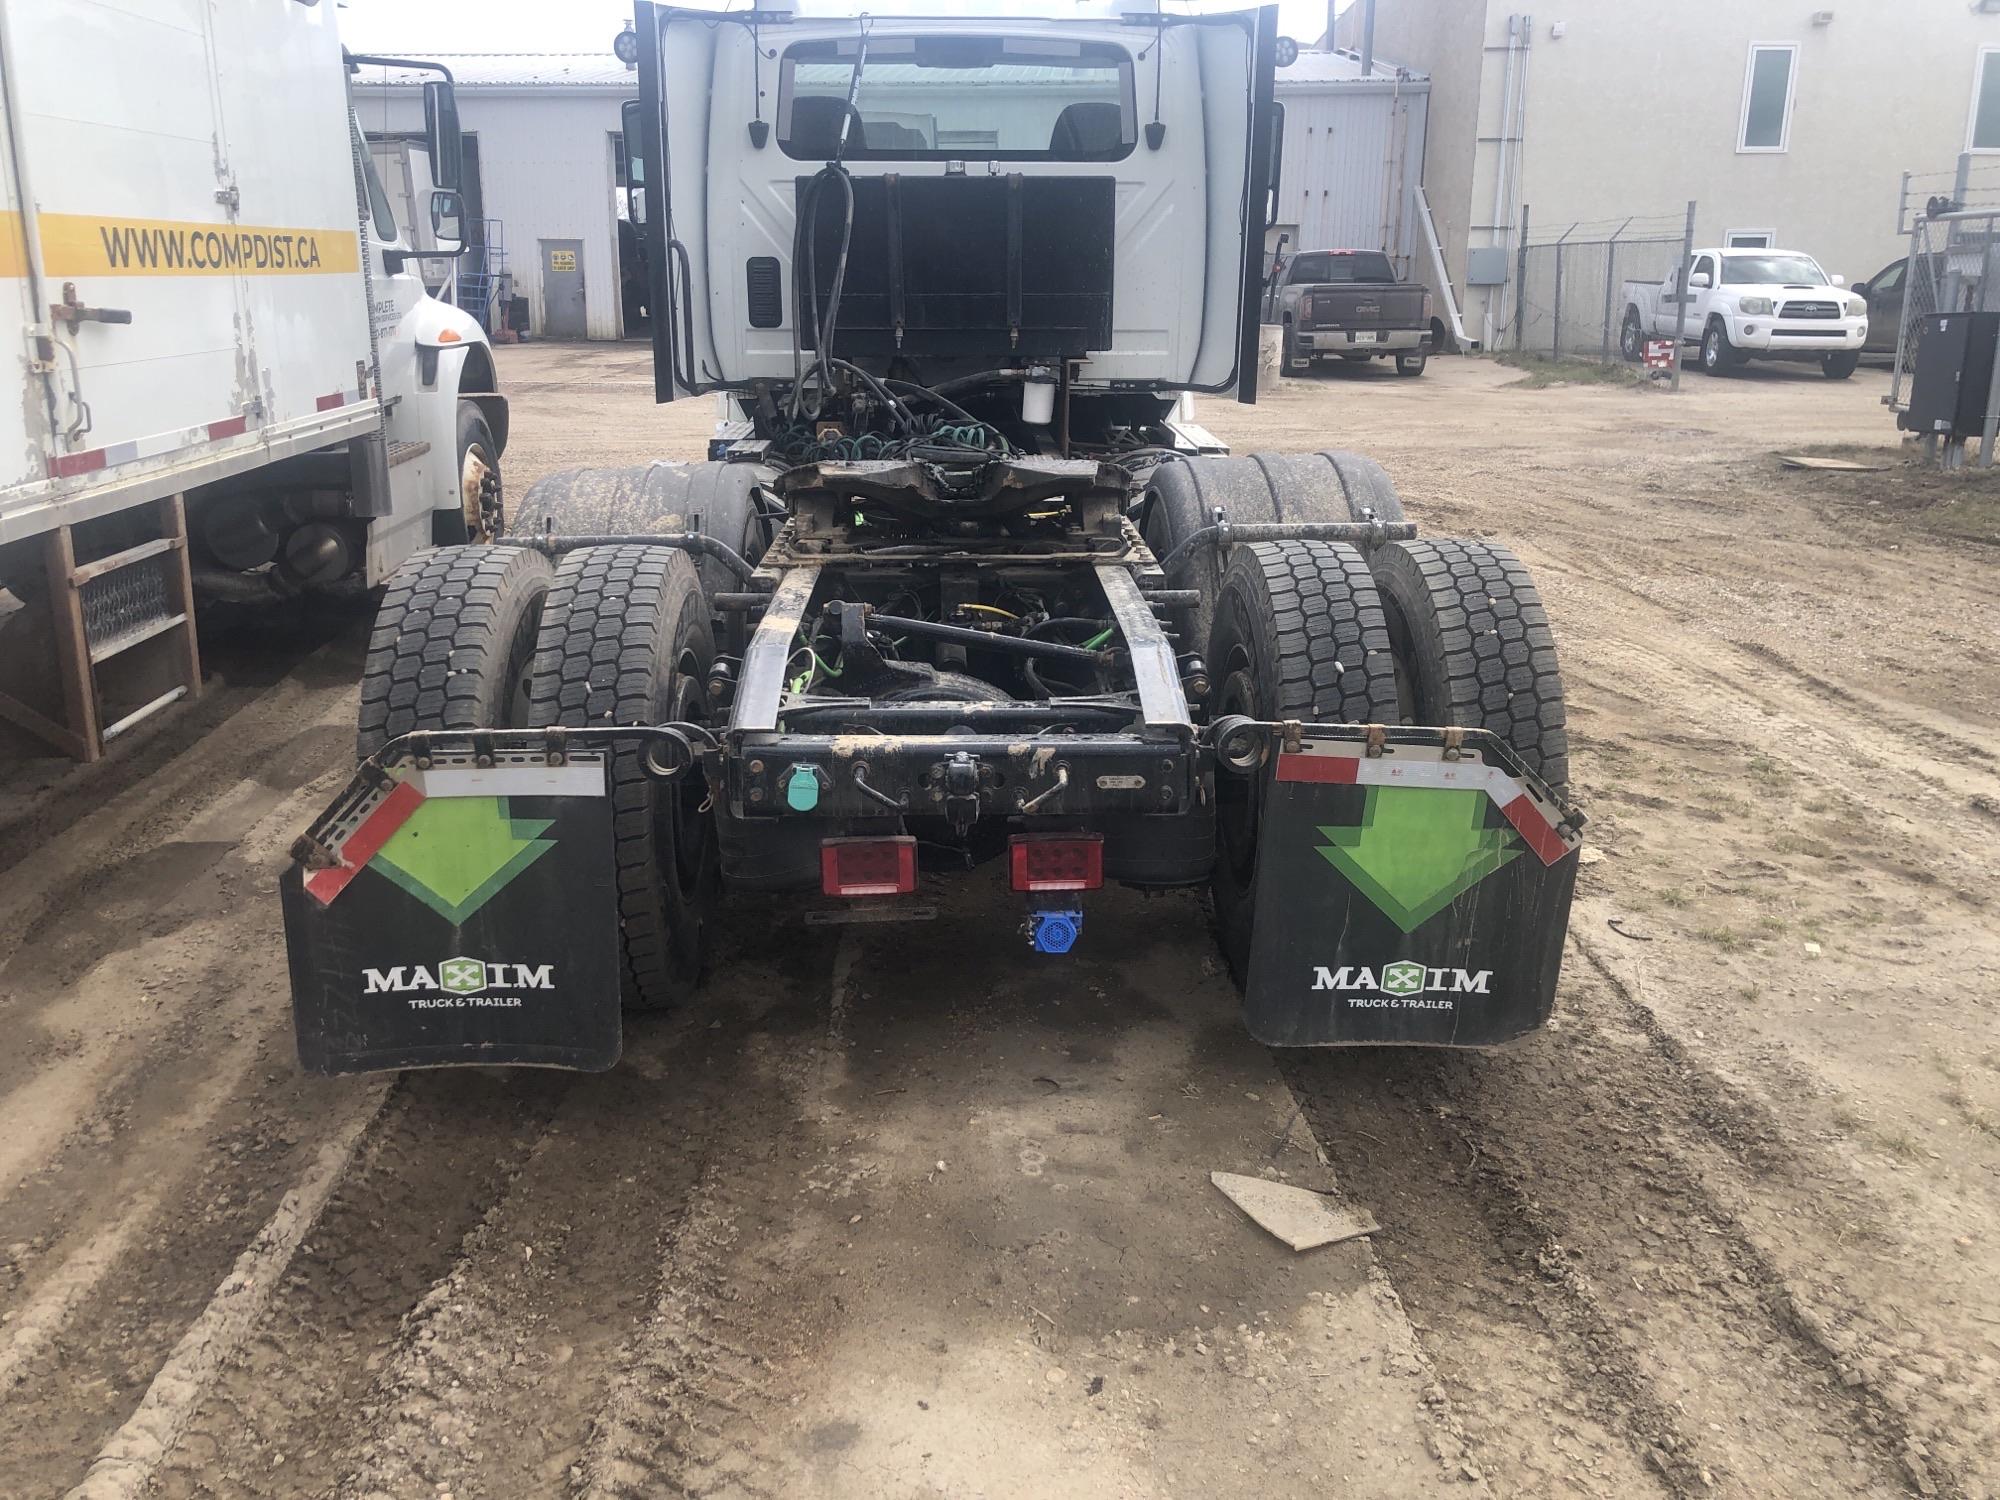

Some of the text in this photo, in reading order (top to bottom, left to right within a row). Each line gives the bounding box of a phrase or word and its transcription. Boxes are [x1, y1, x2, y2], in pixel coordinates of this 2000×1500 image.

[100, 226, 321, 269] WWW.COMPDIST.CA
[362, 957, 555, 994] MAXIM
[1311, 961, 1494, 995] MAXIM
[408, 997, 522, 1009] TRUCK & TRAILER
[1348, 998, 1453, 1010] TRUCK & TRAILER
